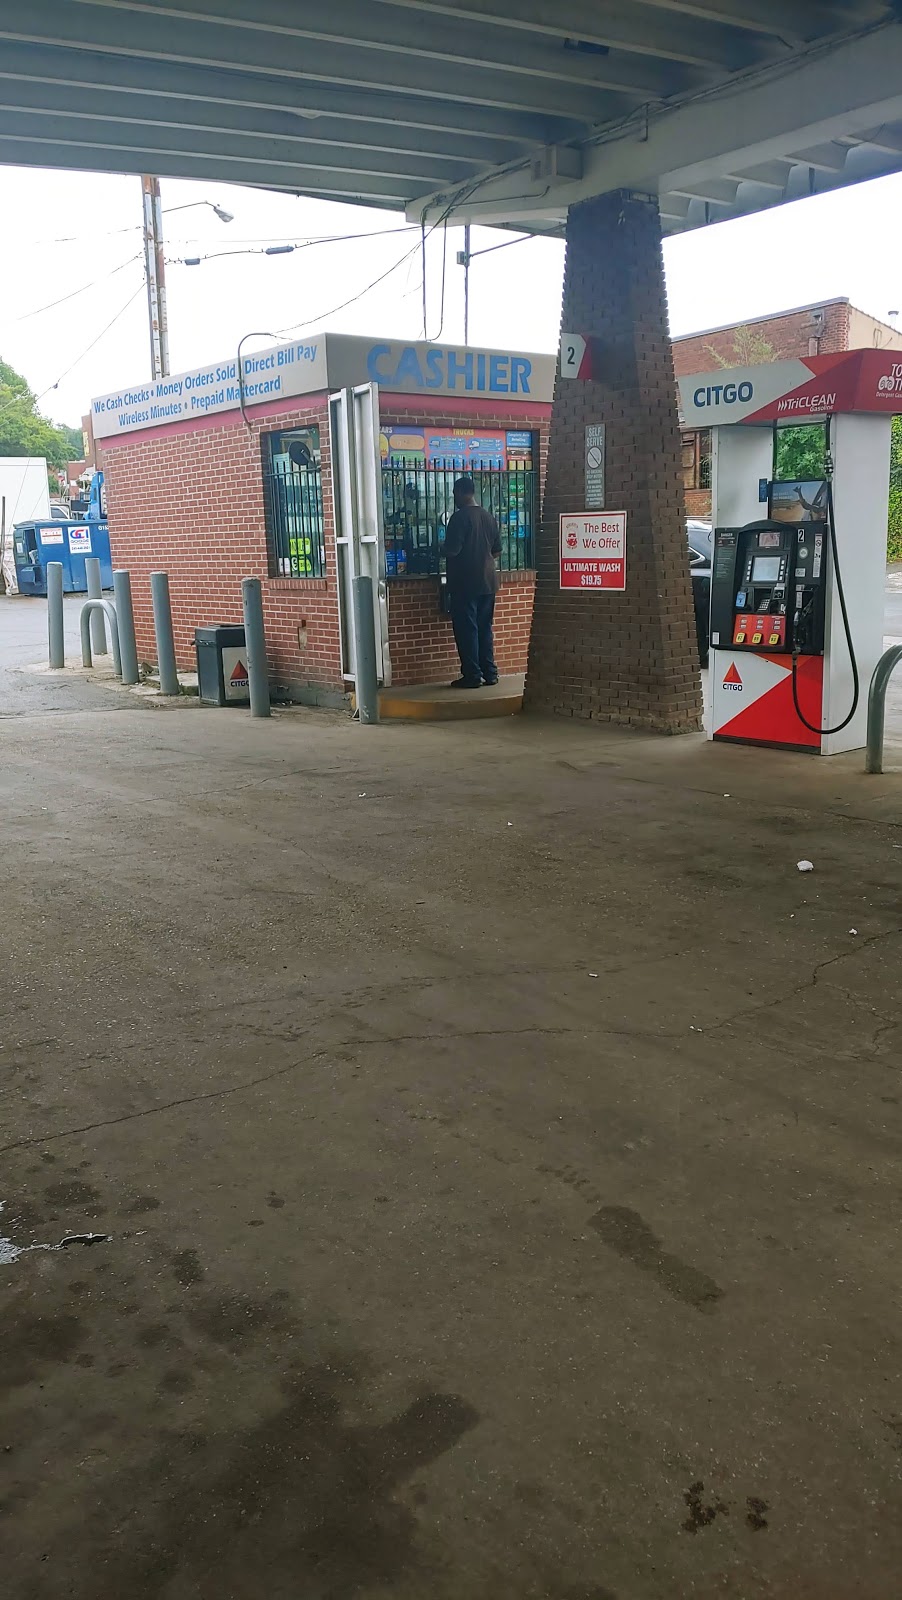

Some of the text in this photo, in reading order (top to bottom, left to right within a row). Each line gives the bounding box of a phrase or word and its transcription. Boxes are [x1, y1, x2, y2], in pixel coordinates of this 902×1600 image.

[567, 346, 575, 365] 2
[366, 344, 532, 393] CASHIER
[94, 345, 318, 413] We Cash Checks Money Orders Sold Direct Bill Pay
[118, 375, 281, 426] Wireless Minutes Prepaid Matercard
[693, 381, 754, 408] CITGO
[787, 393, 836, 410] TriCLEAN
[453, 428, 475, 436] TRUCKS
[588, 426, 602, 437] SELF
[586, 436, 603, 447] SERVE
[583, 522, 599, 533] The
[601, 522, 620, 533] Best
[798, 529, 804, 541] 2
[582, 537, 621, 549] We Offer
[564, 563, 621, 572] ULTIMATE WASH
[581, 574, 602, 586] $19.75
[722, 683, 743, 692] CITGO
